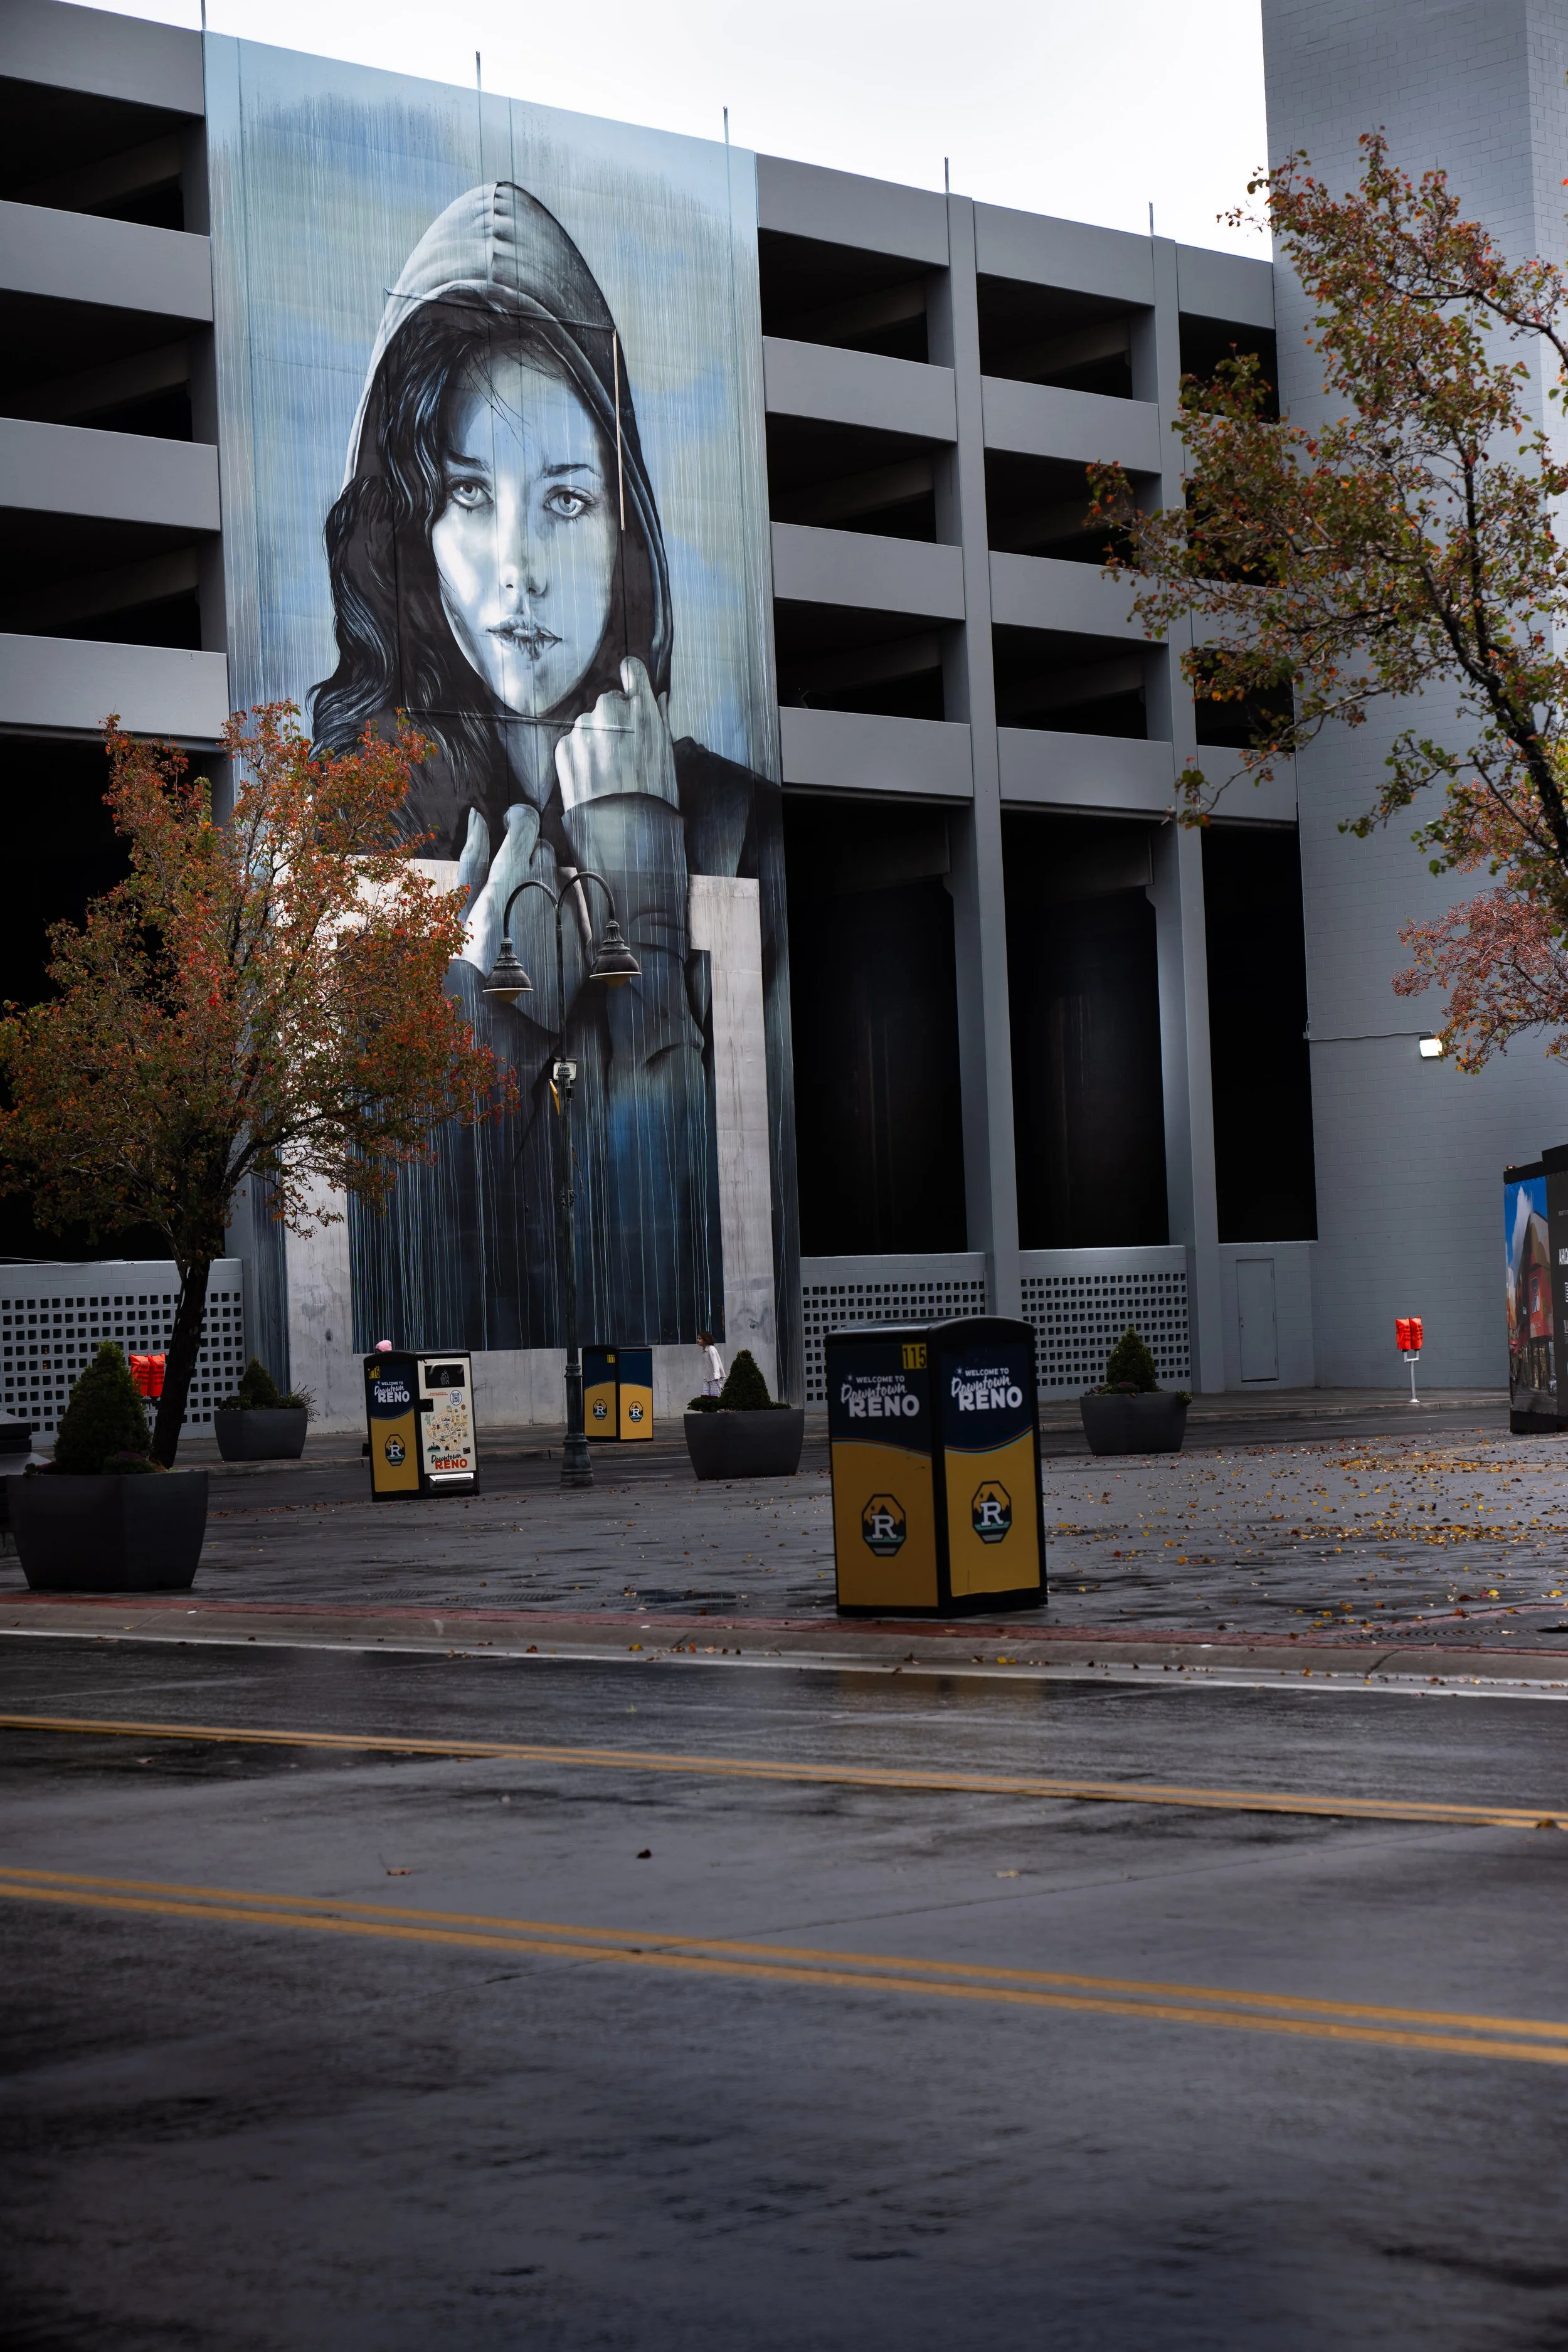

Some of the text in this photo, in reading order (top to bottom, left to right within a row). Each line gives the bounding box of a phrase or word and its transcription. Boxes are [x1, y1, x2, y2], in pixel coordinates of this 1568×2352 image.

[607, 1355, 615, 1363] 117
[903, 1346, 926, 1368] 115
[965, 1369, 999, 1377] WELCOME
[374, 1385, 405, 1396] Downtown
[951, 1374, 1012, 1397] Downtown
[378, 1391, 410, 1403] RENO
[840, 1382, 908, 1404] Downtown
[958, 1386, 1023, 1411] RENO
[596, 1406, 605, 1414] R
[849, 1394, 920, 1417] RENO
[632, 1408, 640, 1417] R
[389, 1444, 402, 1458] R
[431, 1453, 462, 1464] Downtown
[435, 1458, 468, 1470] RENO
[980, 1502, 1004, 1527] R
[871, 1515, 898, 1539] R
